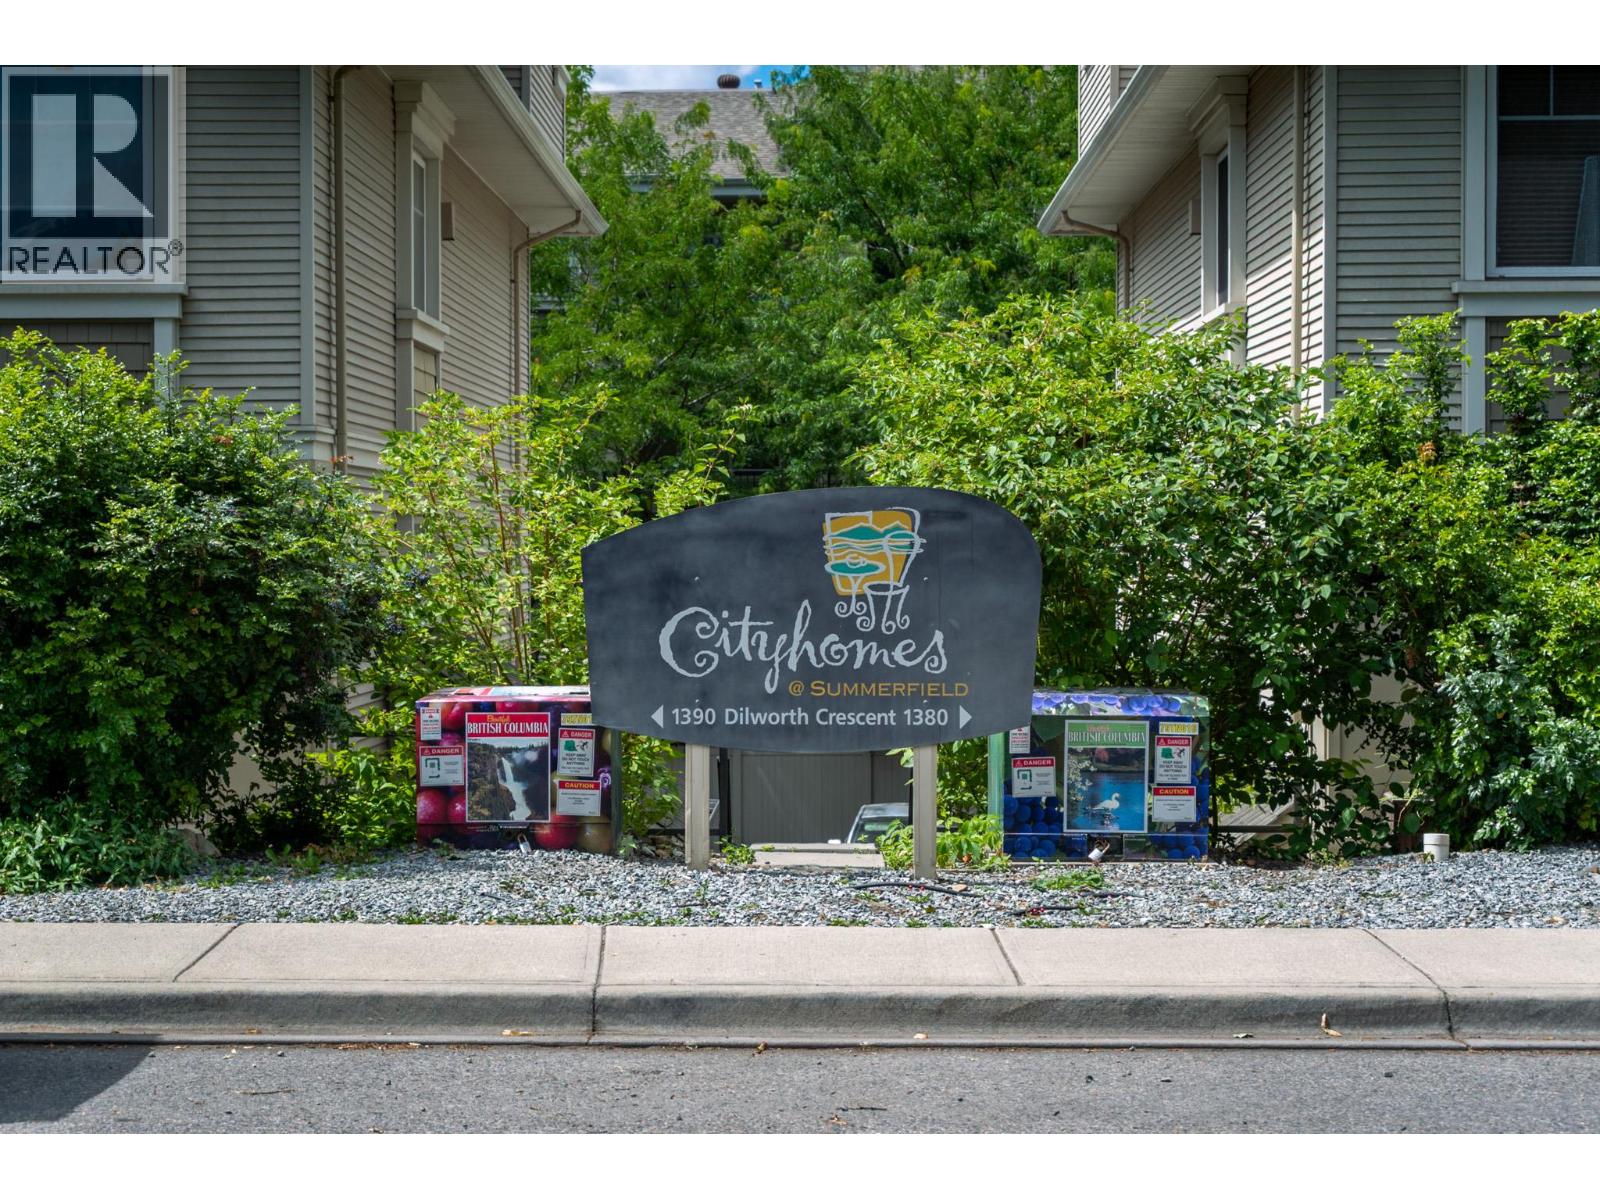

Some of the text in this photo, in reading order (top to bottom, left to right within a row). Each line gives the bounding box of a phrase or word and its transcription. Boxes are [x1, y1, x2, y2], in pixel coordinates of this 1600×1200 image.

[659, 600, 947, 694] Cityhomes
[788, 680, 969, 697] @ SUMMERFIELD
[671, 706, 949, 726] 1390 Dilworth Crescent 1380
[467, 722, 549, 734] BRITISH COLUMBIA
[1068, 731, 1146, 743] BRITISH COLUMBIA
[564, 782, 595, 790] CAUTION
